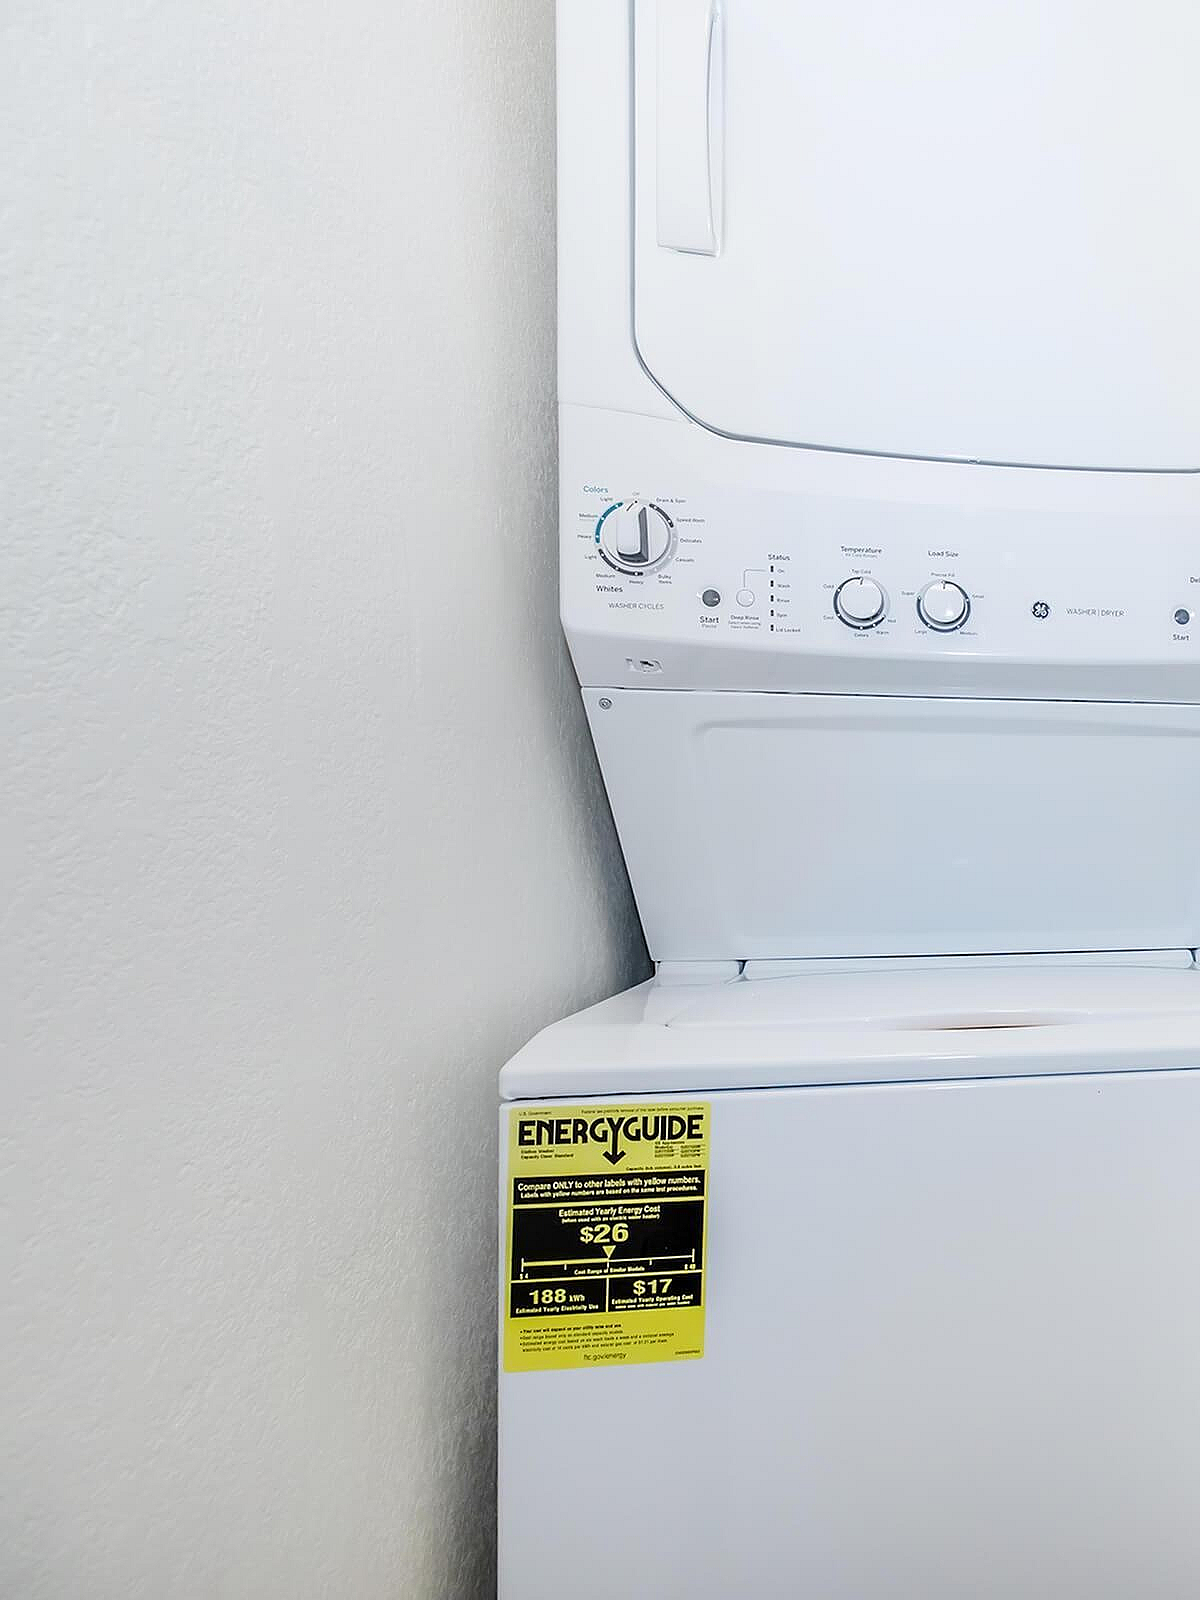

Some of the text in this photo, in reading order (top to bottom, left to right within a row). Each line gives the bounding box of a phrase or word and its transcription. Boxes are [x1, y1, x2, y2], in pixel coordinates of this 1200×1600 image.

[583, 485, 609, 494] Colors
[840, 546, 882, 554] Temperature
[595, 585, 624, 593] Whites
[1066, 608, 1125, 617] WASHER DRYER
[699, 615, 720, 623] Start
[518, 1114, 704, 1146] ENERGYGUIDE
[518, 1175, 701, 1192] Compare ONLY to other labels with yellow numbers.
[520, 1191, 539, 1199] Labels
[552, 1190, 571, 1198] yellow
[558, 1204, 661, 1217] Estimated Yearly Energy Cost
[580, 1223, 629, 1244] $26
[633, 1278, 673, 1296] $17
[528, 1288, 586, 1305] 188 kWh
[611, 1297, 637, 1305] Estimated
[655, 1295, 681, 1303] Operating
[515, 1306, 542, 1314] Estimated
[543, 1305, 560, 1313] Yearly
[561, 1304, 588, 1312] Electricity
